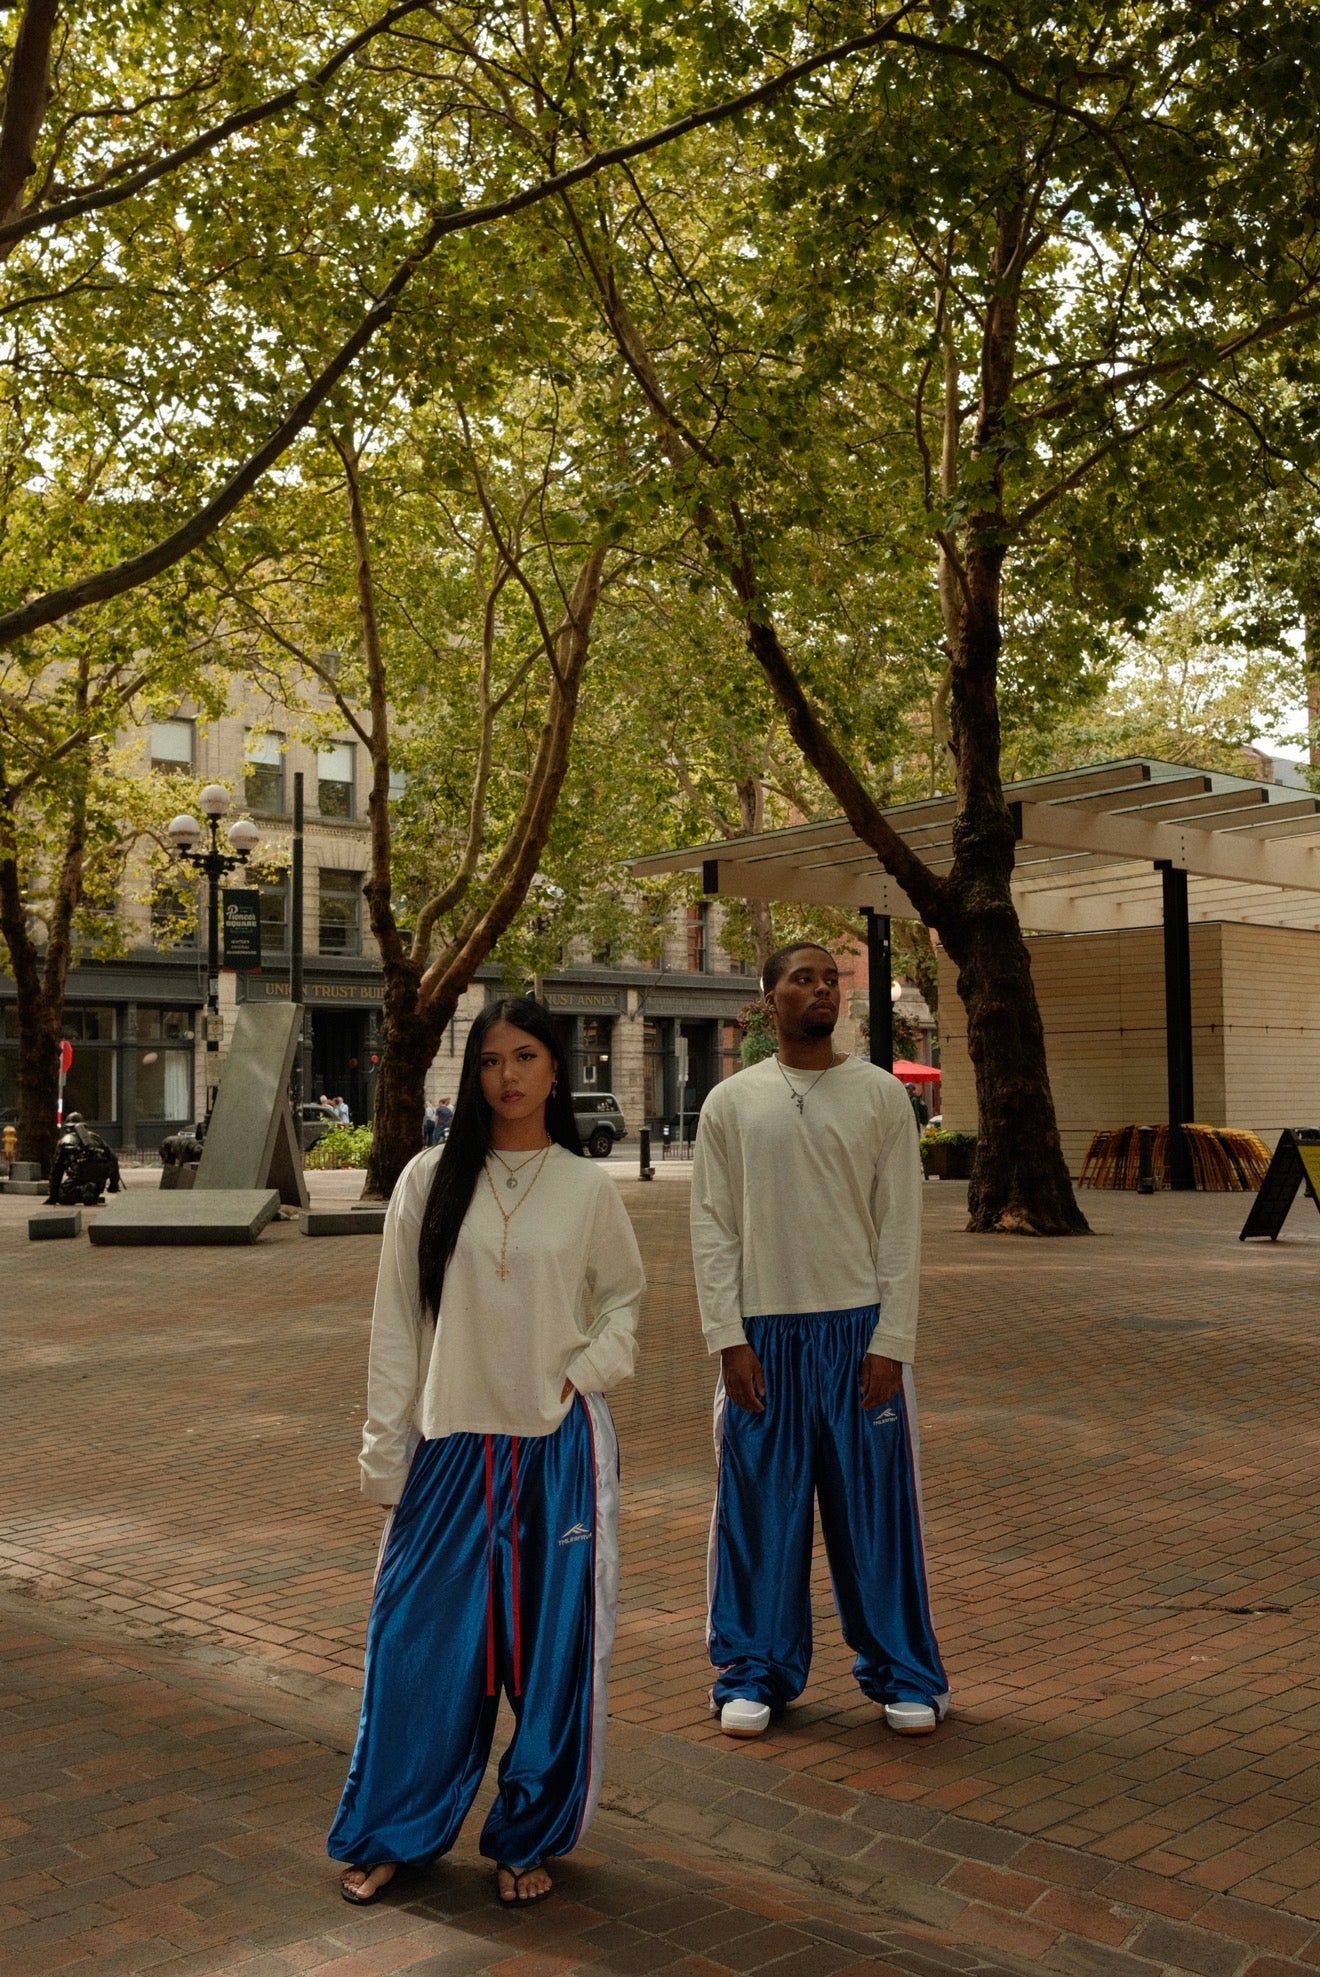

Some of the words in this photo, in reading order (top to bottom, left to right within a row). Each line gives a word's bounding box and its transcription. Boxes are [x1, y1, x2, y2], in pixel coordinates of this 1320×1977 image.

[226, 920, 257, 928] SQUARE
[265, 983, 308, 996] UNIN
[312, 984, 357, 998] TRUST
[544, 993, 577, 1006] RUST
[577, 994, 616, 1007] ANNEX
